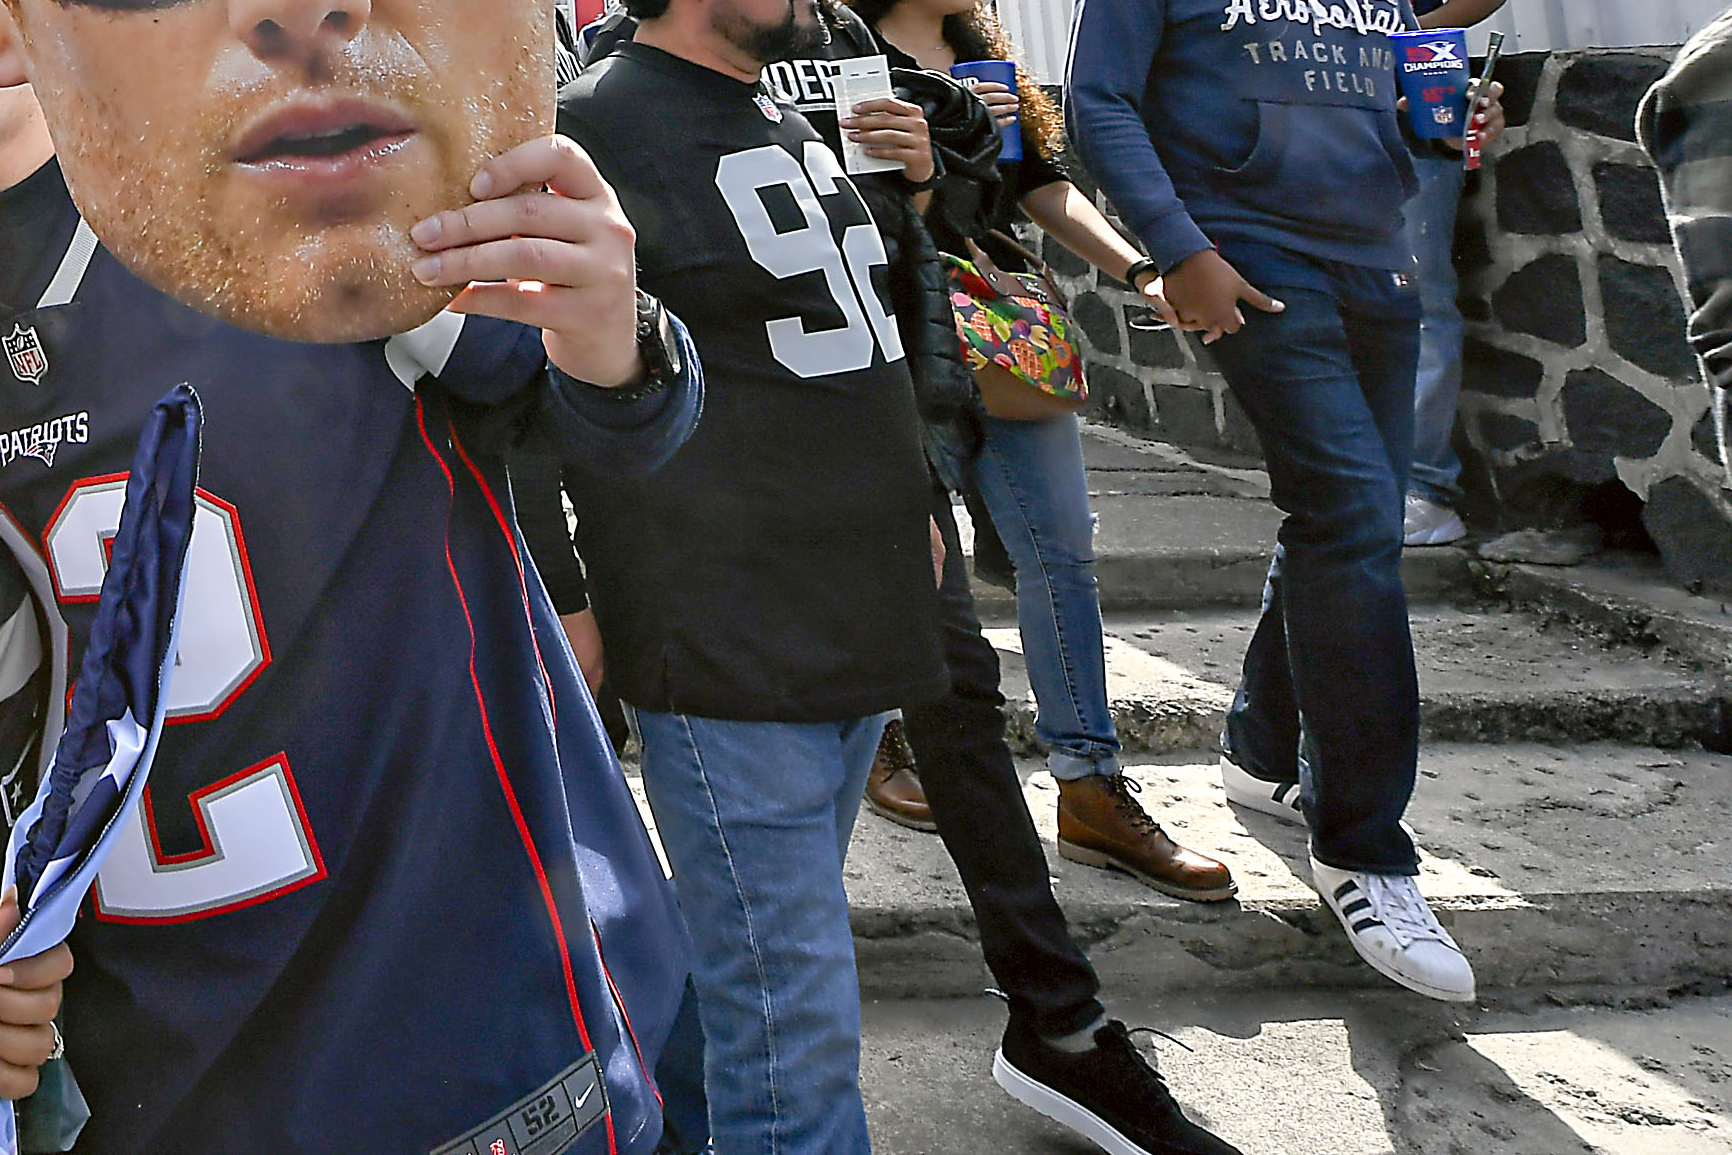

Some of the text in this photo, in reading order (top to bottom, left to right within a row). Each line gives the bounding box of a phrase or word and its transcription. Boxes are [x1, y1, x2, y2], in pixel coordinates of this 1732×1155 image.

[1244, 40, 1395, 71] TRACK AND
[1404, 59, 1464, 72] CHAMPIONS
[1304, 70, 1375, 97] FIELD
[715, 141, 906, 379] 92
[14, 351, 42, 374] NFL
[522, 1095, 561, 1136] 52
